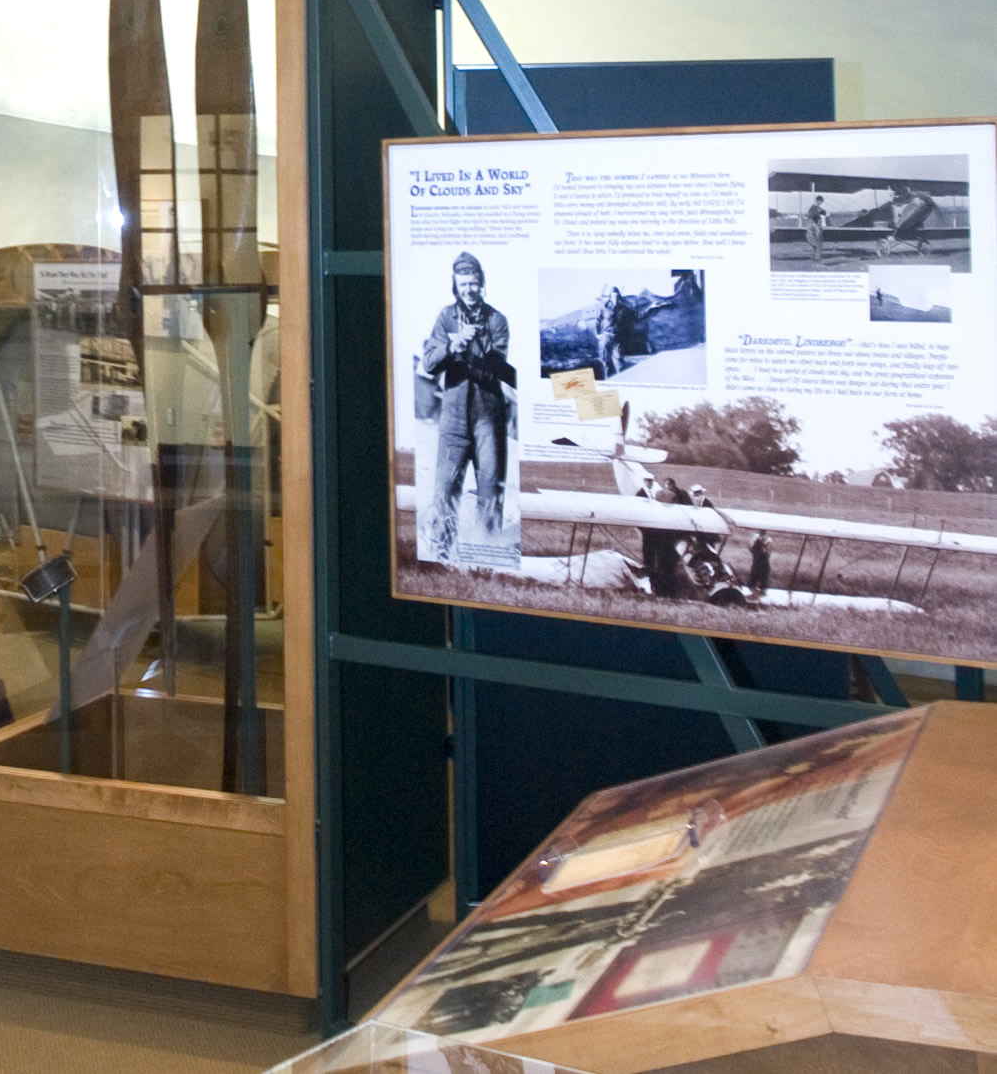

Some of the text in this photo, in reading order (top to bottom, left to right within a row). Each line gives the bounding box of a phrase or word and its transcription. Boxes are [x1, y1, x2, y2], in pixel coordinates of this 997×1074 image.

[424, 170, 455, 182] LIVED
[459, 169, 471, 181] IN
[475, 169, 484, 181] A
[488, 168, 529, 181] WORLD
[410, 185, 426, 197] OF
[429, 184, 471, 197] CLOUDS
[475, 184, 500, 196] AND
